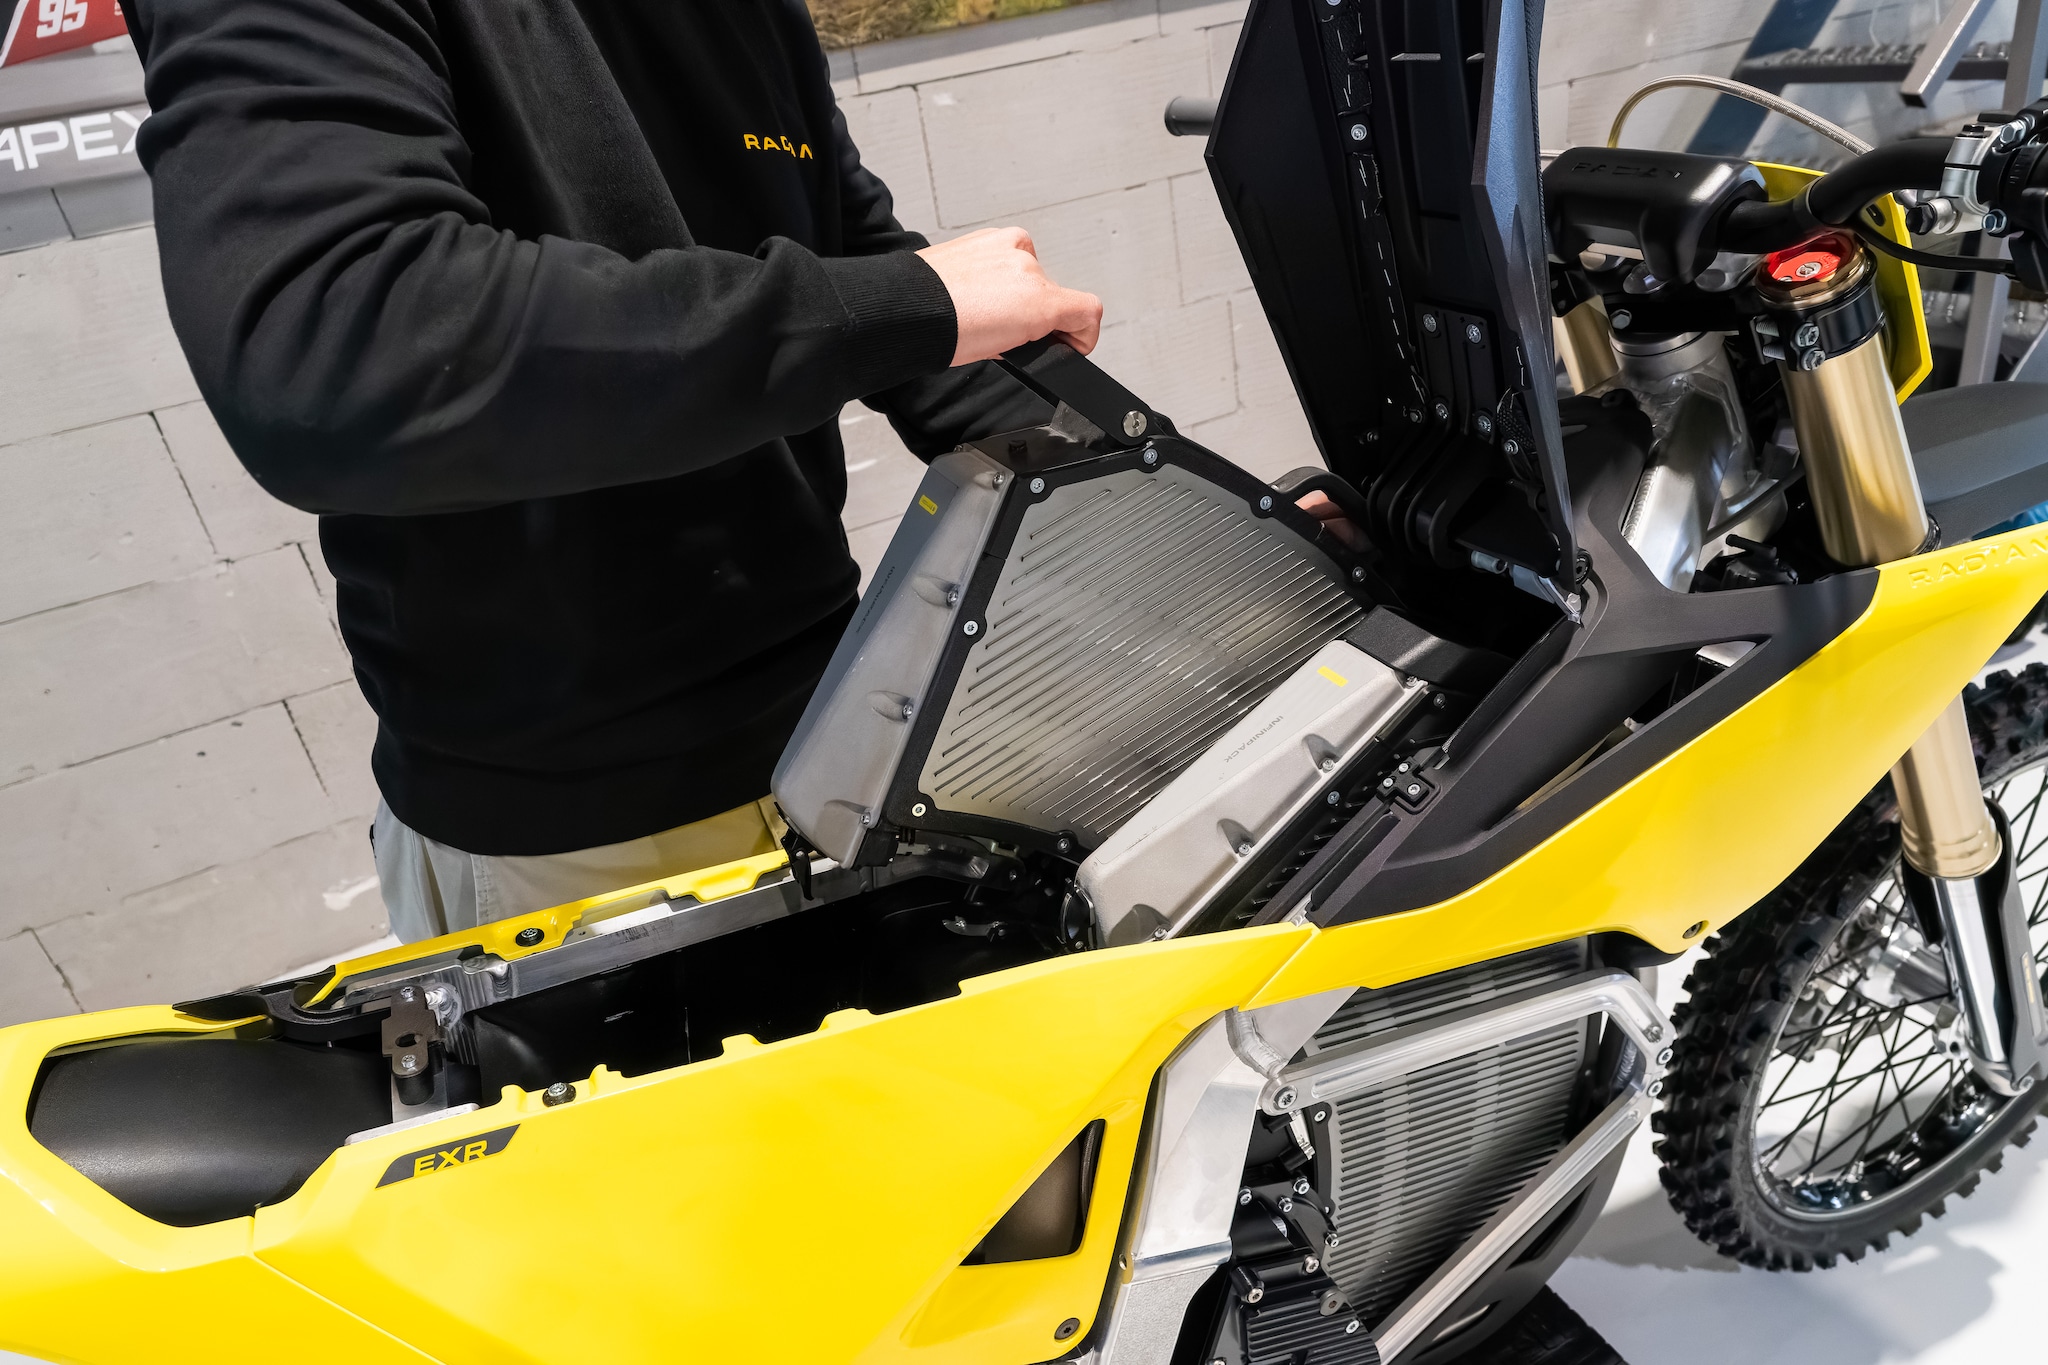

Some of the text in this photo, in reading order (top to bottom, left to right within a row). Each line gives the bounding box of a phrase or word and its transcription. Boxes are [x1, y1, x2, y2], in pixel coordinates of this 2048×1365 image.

[36, 0, 88, 38] 95
[0, 110, 152, 172] APEX
[1224, 715, 1284, 763] INFINIPACK
[413, 1139, 488, 1178] EXR
